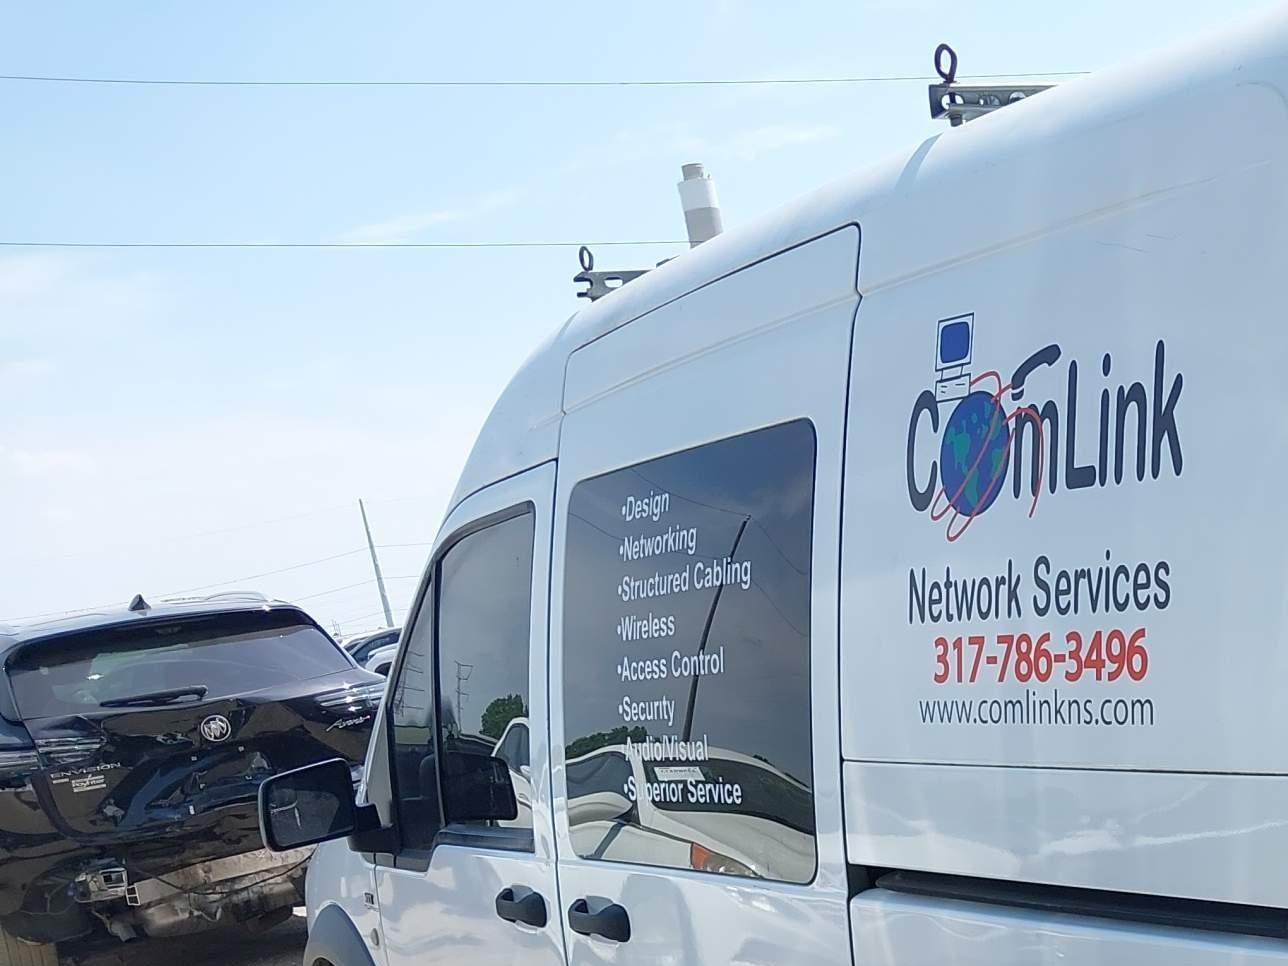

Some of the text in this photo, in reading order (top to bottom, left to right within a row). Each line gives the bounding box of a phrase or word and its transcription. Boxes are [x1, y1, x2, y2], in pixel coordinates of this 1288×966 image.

[906, 338, 1184, 514] ComLink
[694, 559, 751, 589] Cabling
[909, 549, 1171, 624] Network Services
[671, 647, 724, 676] Control
[933, 628, 1148, 684] 317-786-3496
[920, 688, 1155, 726] www.comlinkns.com
[50, 761, 121, 778] ENVISION
[628, 776, 742, 804] Sperior Service
